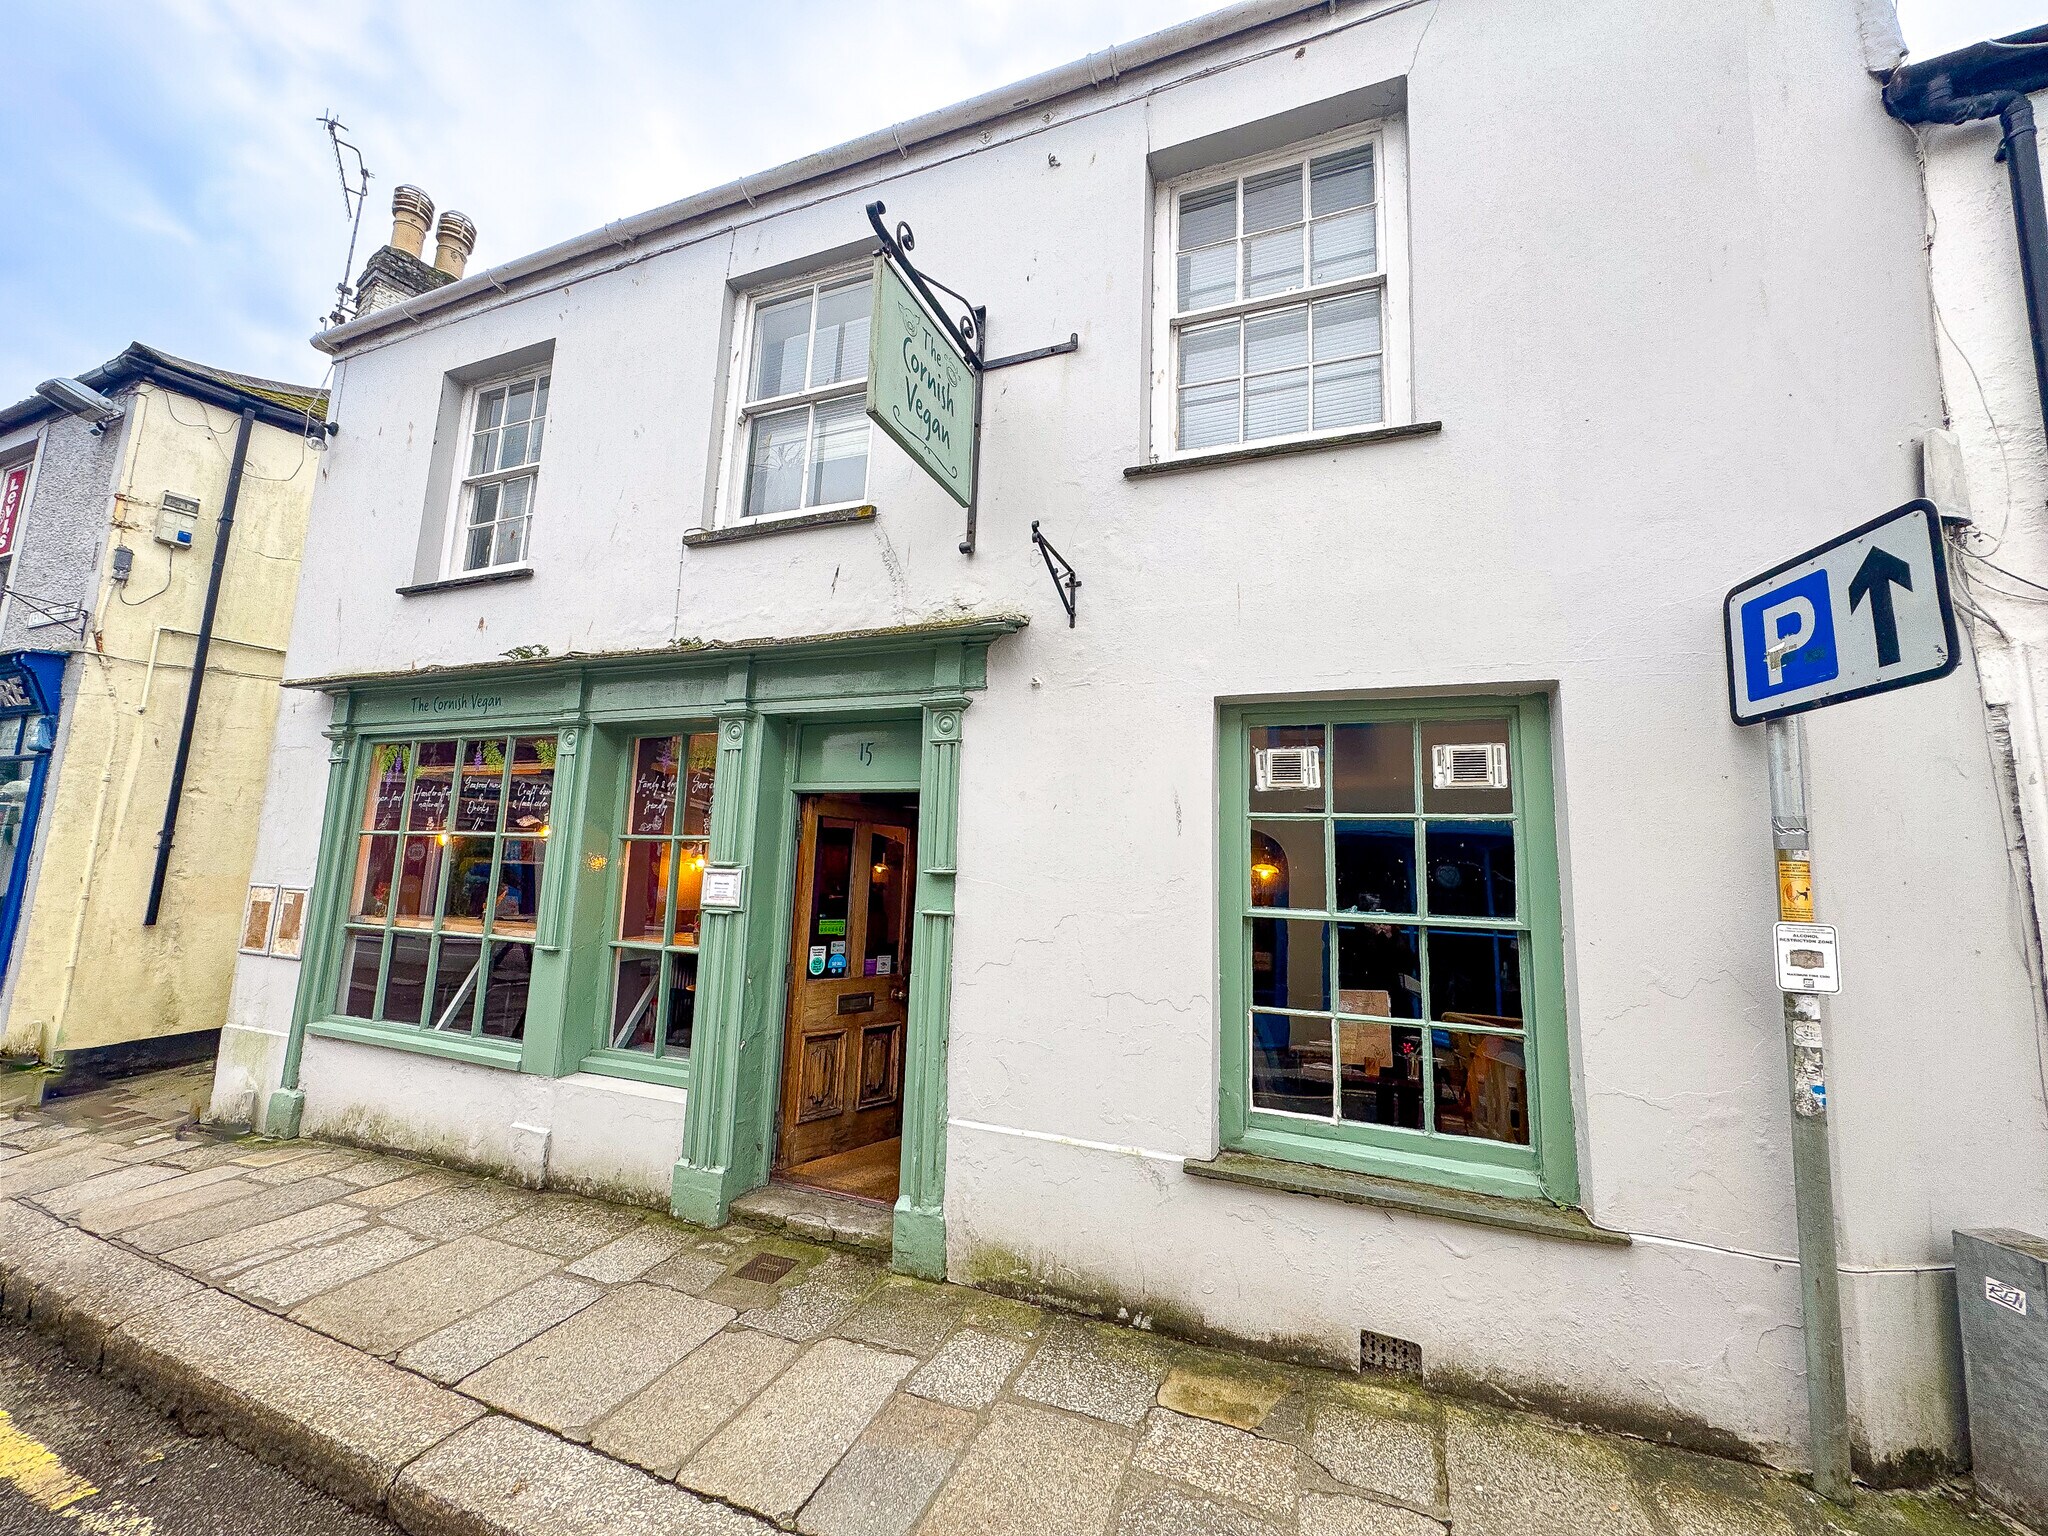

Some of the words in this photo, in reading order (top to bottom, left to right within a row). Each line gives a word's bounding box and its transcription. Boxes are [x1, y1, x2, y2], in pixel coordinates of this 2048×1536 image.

[921, 326, 943, 368] The
[902, 336, 955, 418] Cornish
[904, 375, 951, 450] Vegan
[1762, 595, 1816, 687] P
[410, 696, 430, 714] The
[433, 695, 468, 714] Cornish
[471, 692, 502, 715] Vegan
[859, 742, 875, 767] 15
[466, 800, 490, 815] Drinks
[517, 782, 538, 801] Craft
